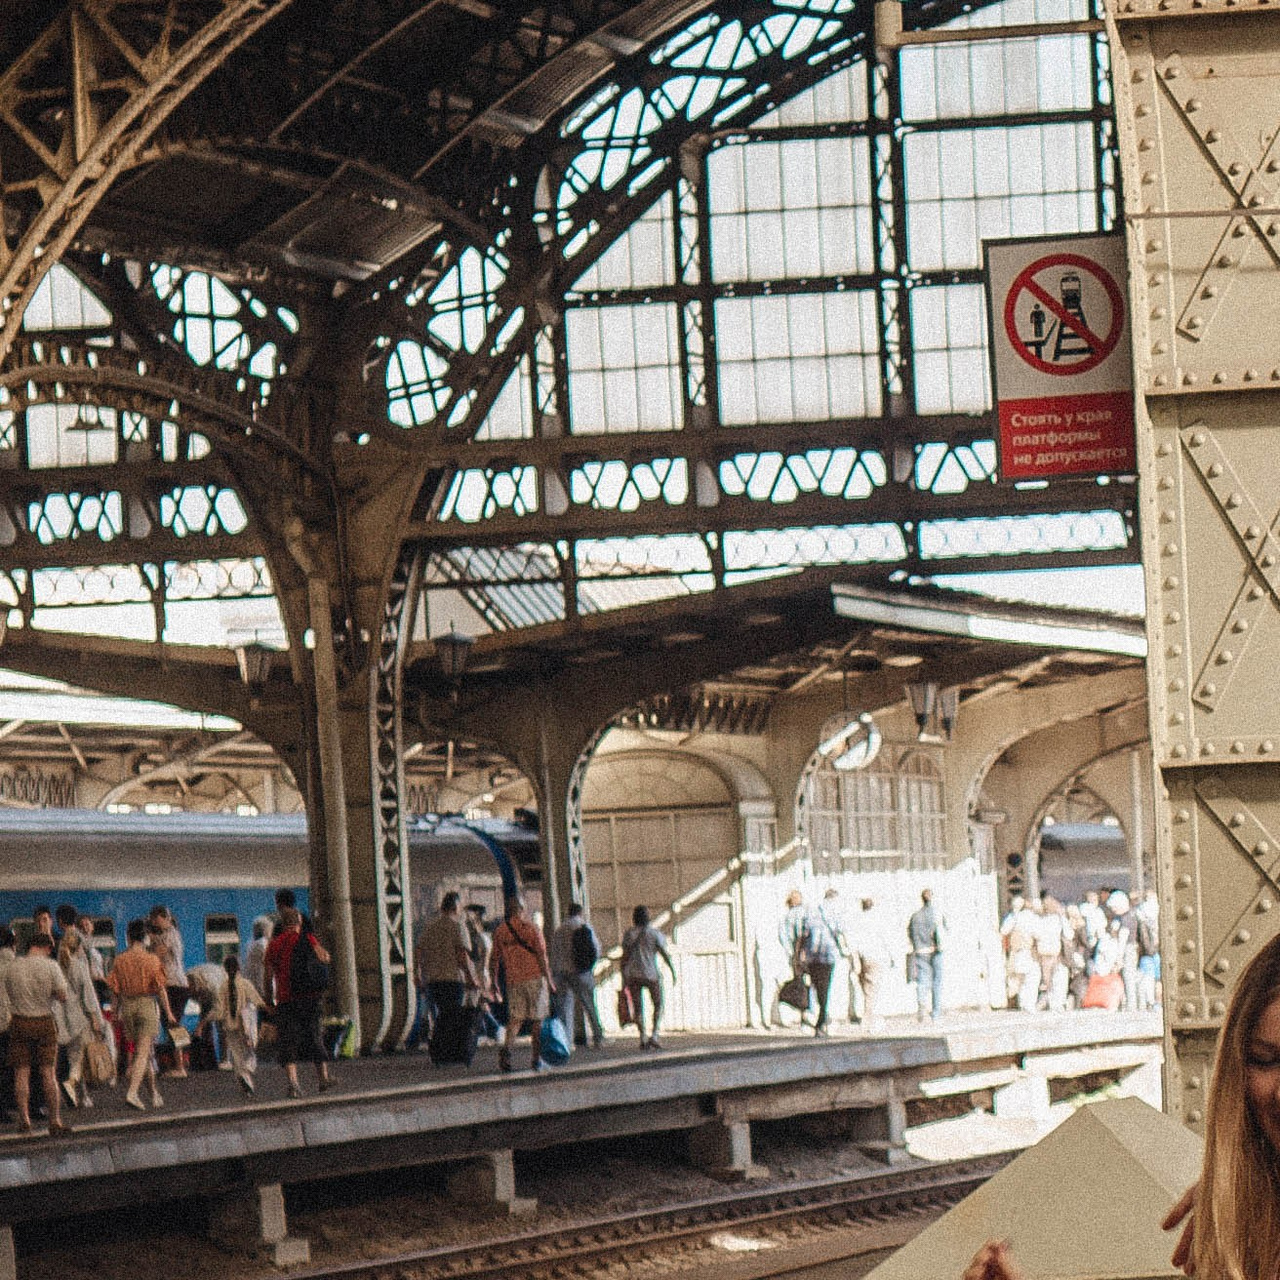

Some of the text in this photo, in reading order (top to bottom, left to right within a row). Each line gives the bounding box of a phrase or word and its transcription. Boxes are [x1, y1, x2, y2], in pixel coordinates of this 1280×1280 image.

[1011, 410, 1112, 428] Стоять у края
[1012, 430, 1101, 447] платформы
[1013, 447, 1128, 466] не допускается
